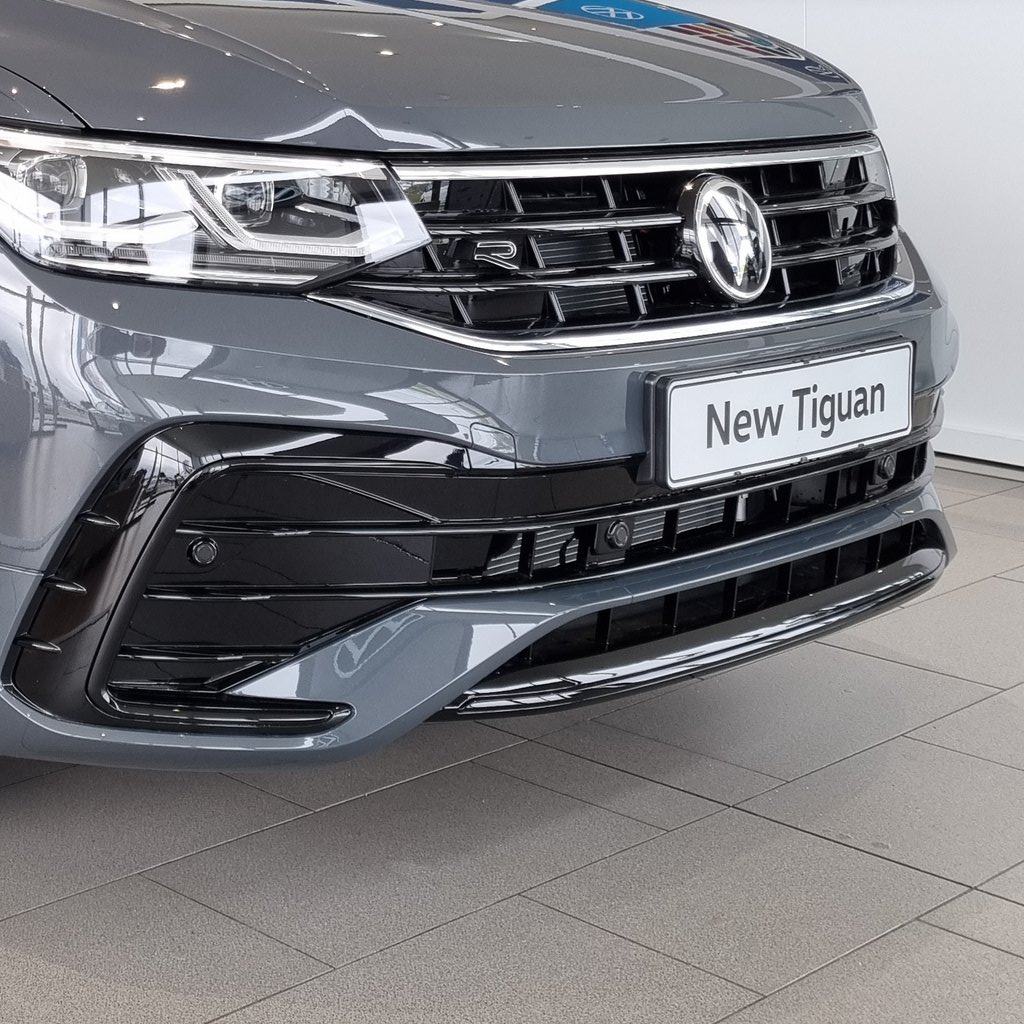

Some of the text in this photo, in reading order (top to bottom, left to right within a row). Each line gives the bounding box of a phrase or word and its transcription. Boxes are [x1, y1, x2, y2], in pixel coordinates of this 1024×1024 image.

[474, 240, 519, 270] R
[707, 382, 885, 449] New Tiguan
